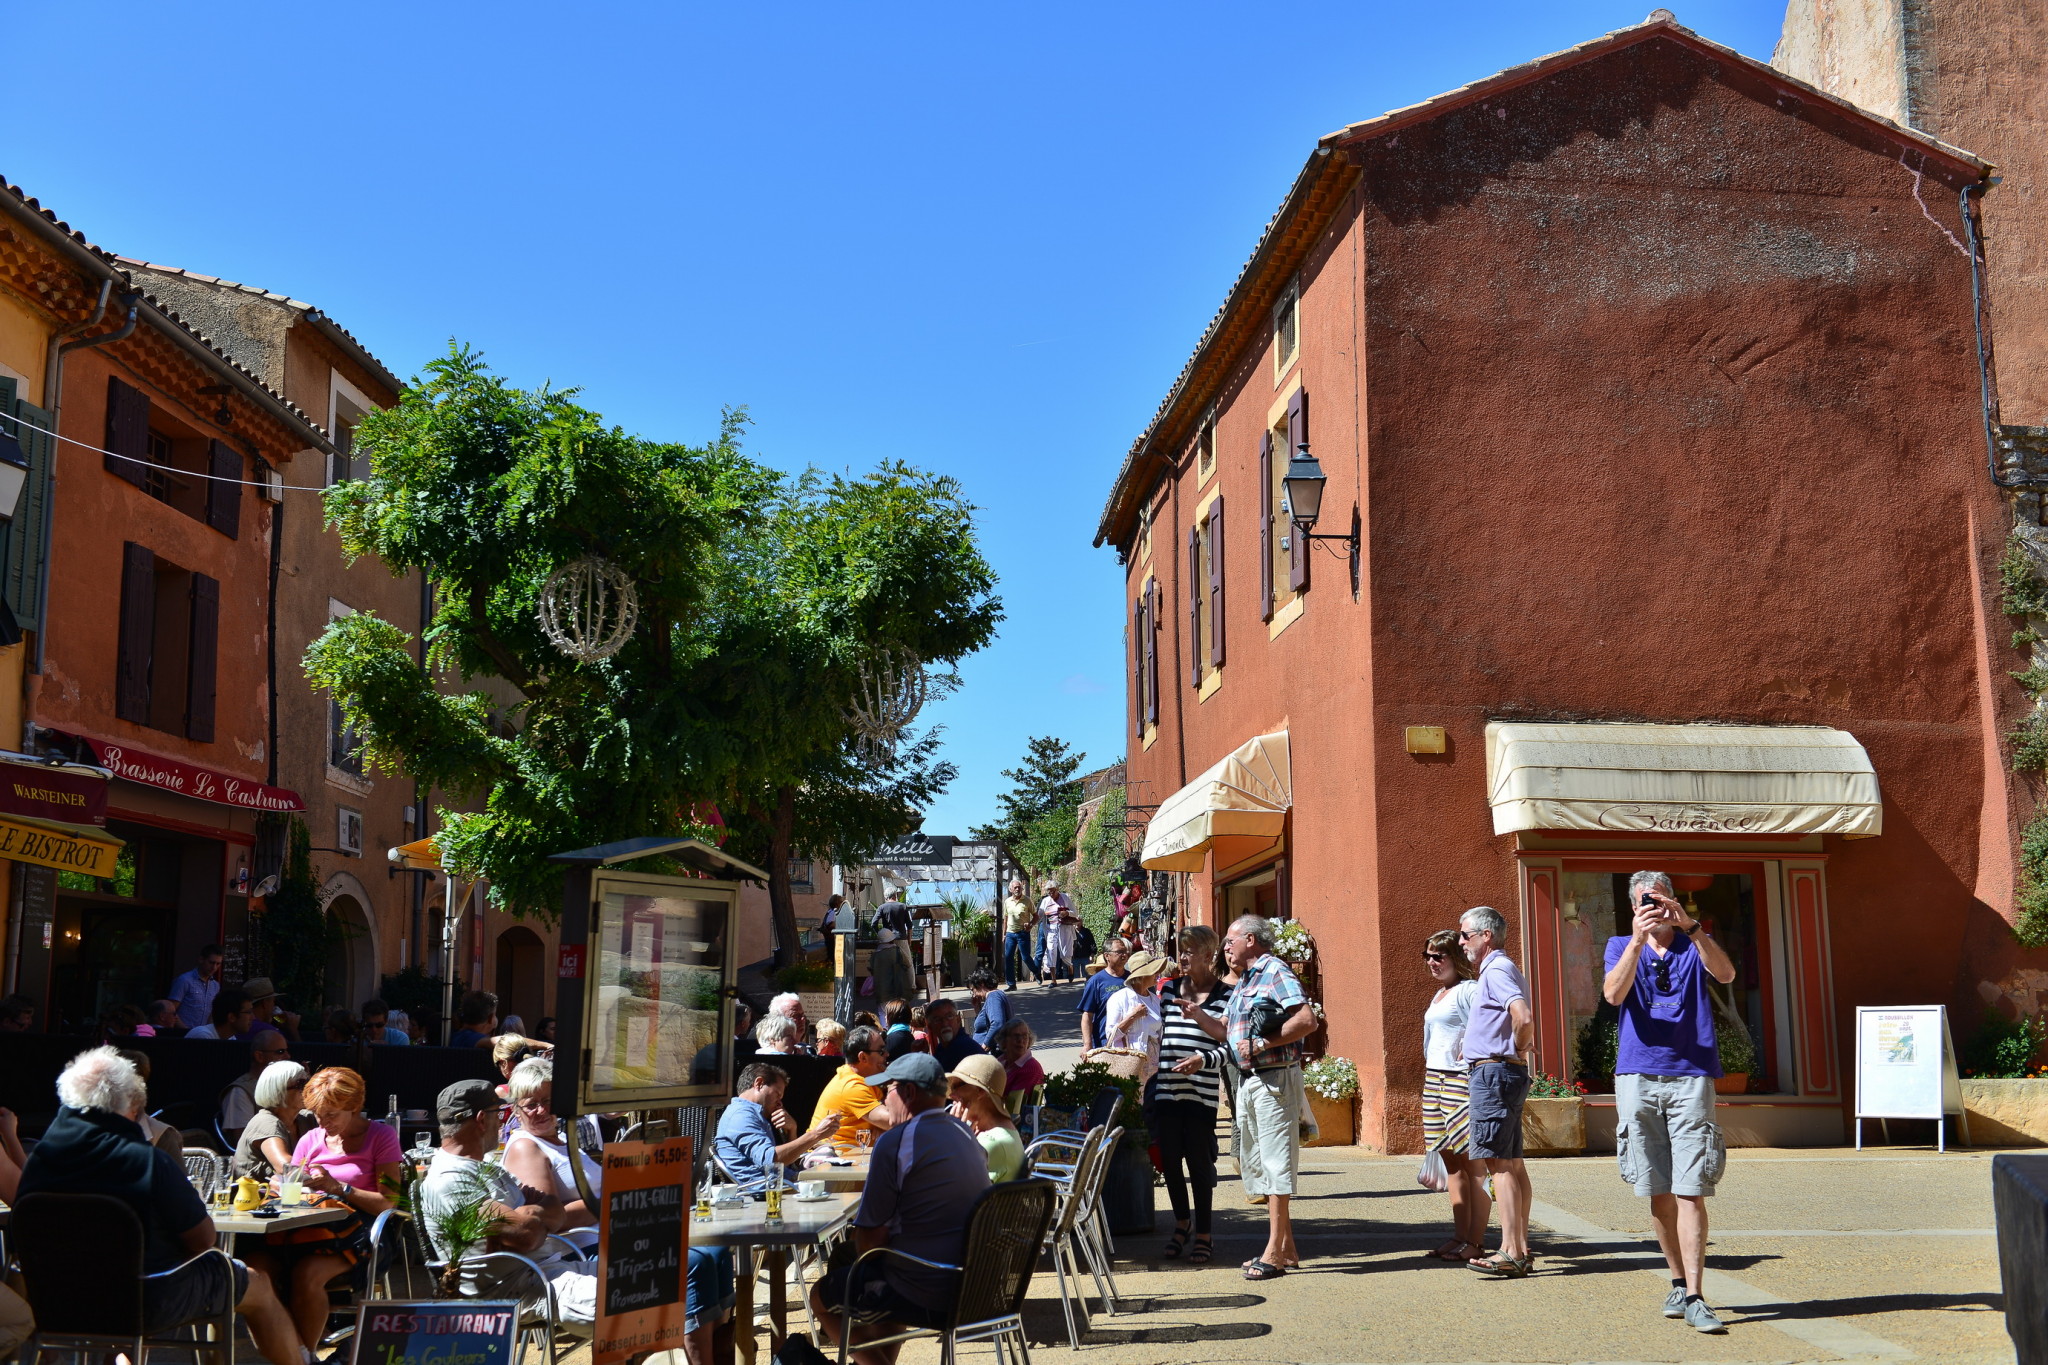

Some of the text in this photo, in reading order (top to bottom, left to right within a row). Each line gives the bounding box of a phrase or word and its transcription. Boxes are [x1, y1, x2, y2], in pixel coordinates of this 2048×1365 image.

[103, 745, 297, 810] Brasserie Le Castrum
[13, 783, 87, 808] WARSTEINER
[1597, 804, 1753, 831] Garance
[19, 832, 104, 870] BISTROT
[562, 953, 578, 967] ici
[607, 1146, 688, 1169] Formule 15,50€
[614, 1257, 655, 1285] Tripes
[371, 1312, 513, 1336] RESTAURANT
[598, 1325, 680, 1355] Dessert au choix
